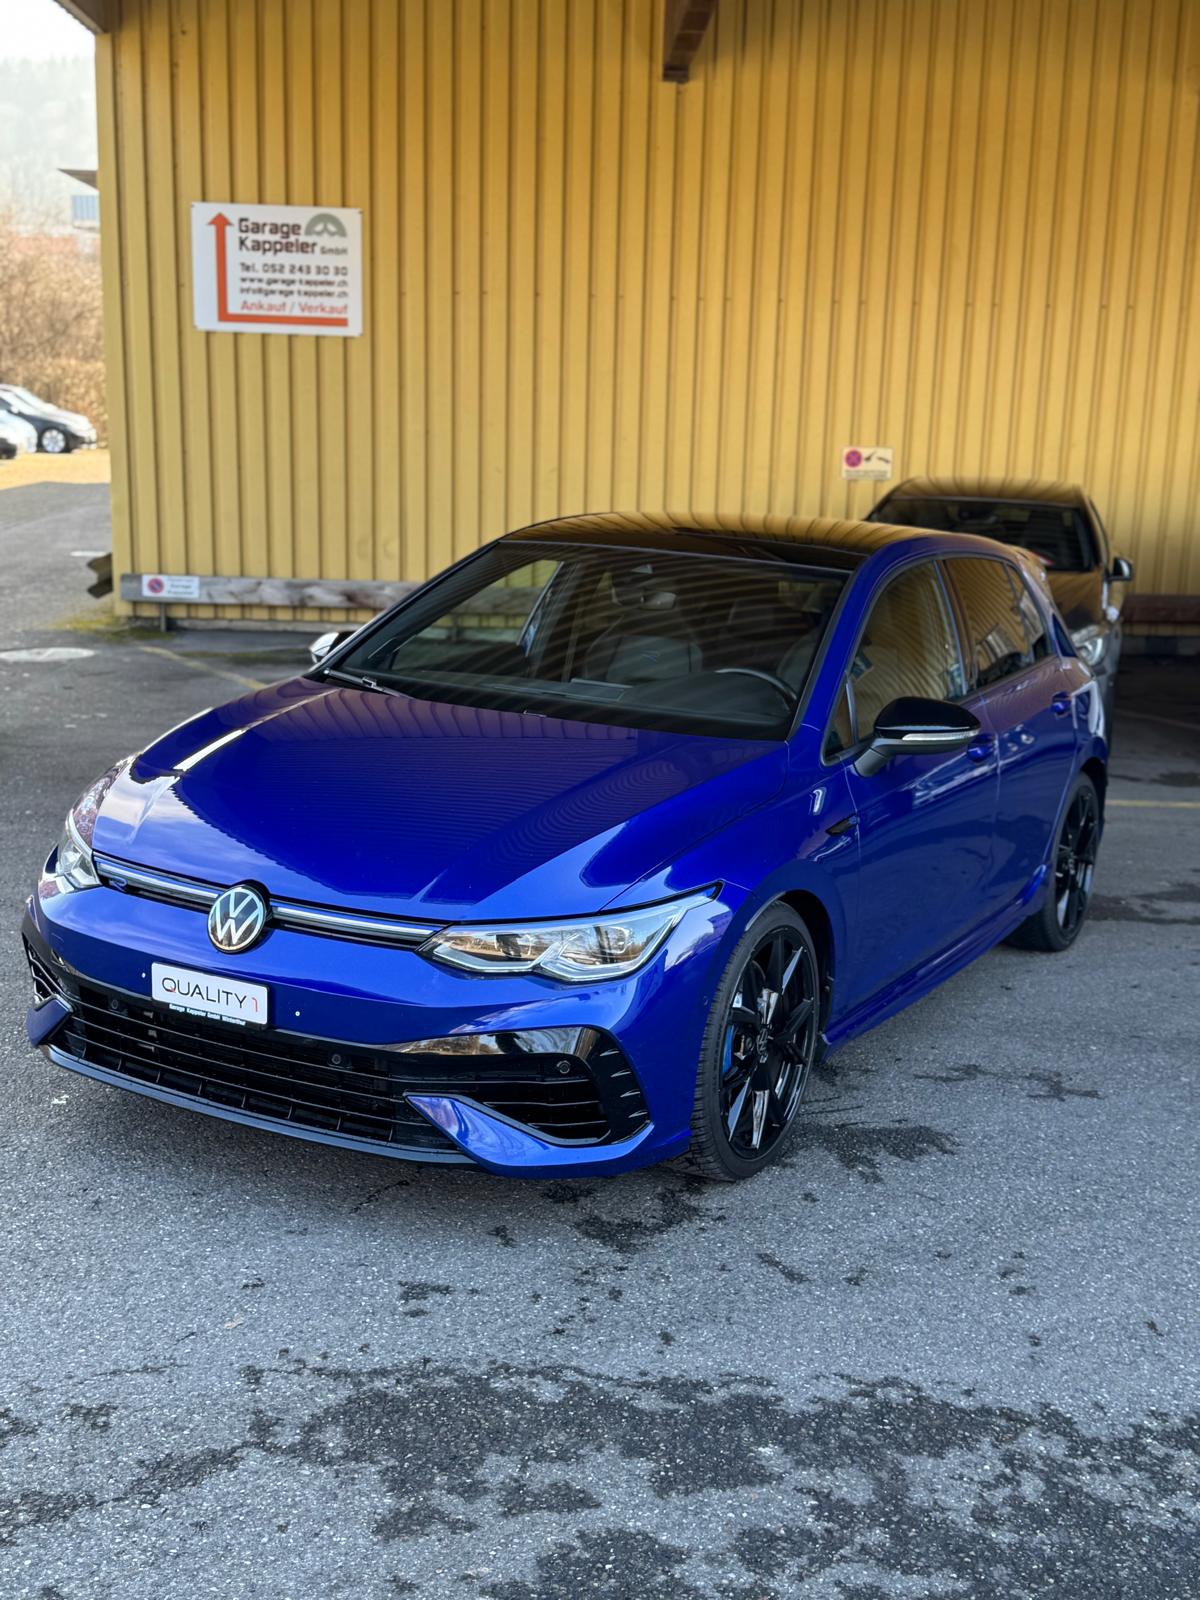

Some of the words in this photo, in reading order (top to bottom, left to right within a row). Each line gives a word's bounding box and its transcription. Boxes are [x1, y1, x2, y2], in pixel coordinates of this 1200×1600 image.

[238, 218, 301, 239] Garage
[238, 236, 317, 256] Kappeler
[320, 246, 348, 255] GmbH
[240, 262, 258, 273] Tel.
[262, 263, 285, 274] 052
[289, 264, 311, 275] 243
[315, 265, 329, 276] 30
[333, 266, 348, 276] 30
[240, 276, 348, 288] www.garagekappeler.ch
[240, 287, 348, 299] info@garagekappeler.ch
[240, 300, 286, 312] Ankauf
[298, 301, 348, 314] Verkauf
[161, 977, 247, 1009] QUALITY
